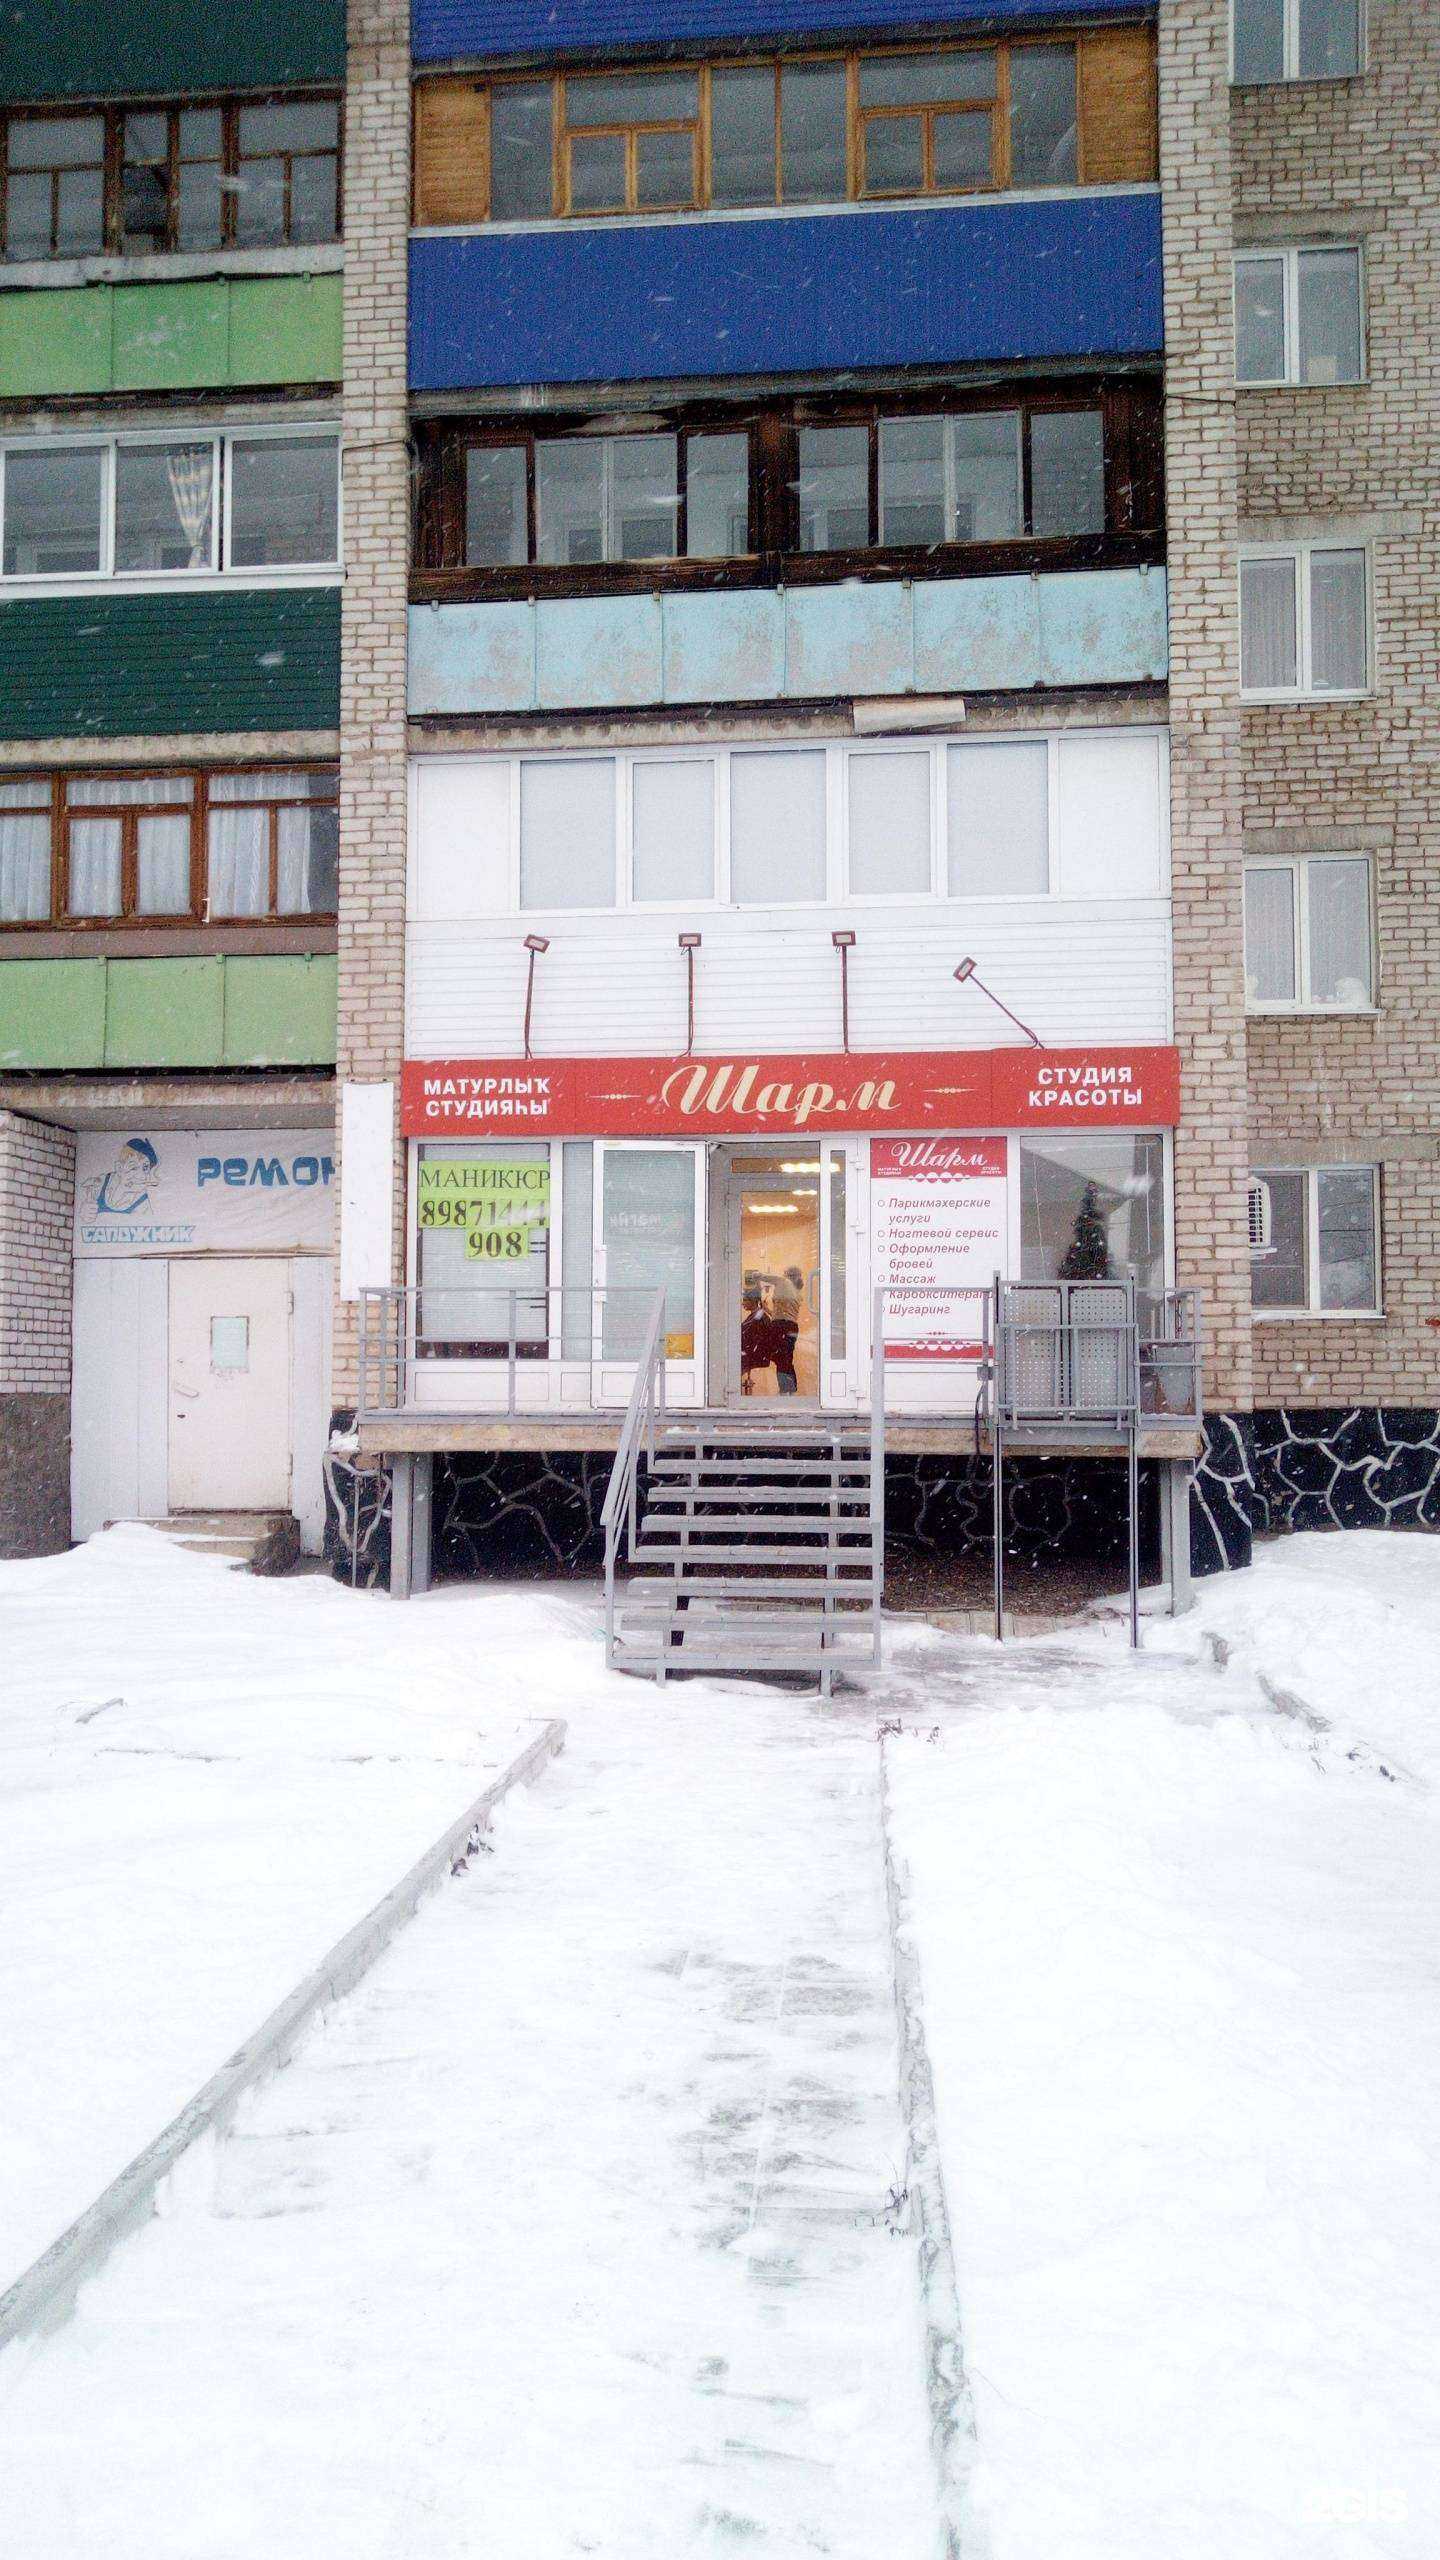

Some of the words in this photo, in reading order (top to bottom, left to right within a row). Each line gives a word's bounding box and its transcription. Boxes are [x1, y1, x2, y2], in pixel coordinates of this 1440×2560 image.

[1038, 1066, 1132, 1087] СТУДИЯ
[661, 1064, 902, 1126] Шарм
[1028, 1088, 1142, 1107] КРАСОТЫ
[890, 1141, 988, 1170] Шарм
[420, 1169, 550, 1190] МАНИКЮР
[889, 1198, 991, 1209] Парикмахерские
[421, 1200, 548, 1226] 89871444
[888, 1214, 931, 1225] услуги
[889, 1227, 952, 1239] Ногтевой
[955, 1229, 999, 1240] сервис
[469, 1233, 523, 1258] 908
[889, 1243, 970, 1256] Оформление
[889, 1258, 933, 1271] бровей
[889, 1274, 936, 1284] Массаж
[889, 1304, 951, 1317] Шугаринг
